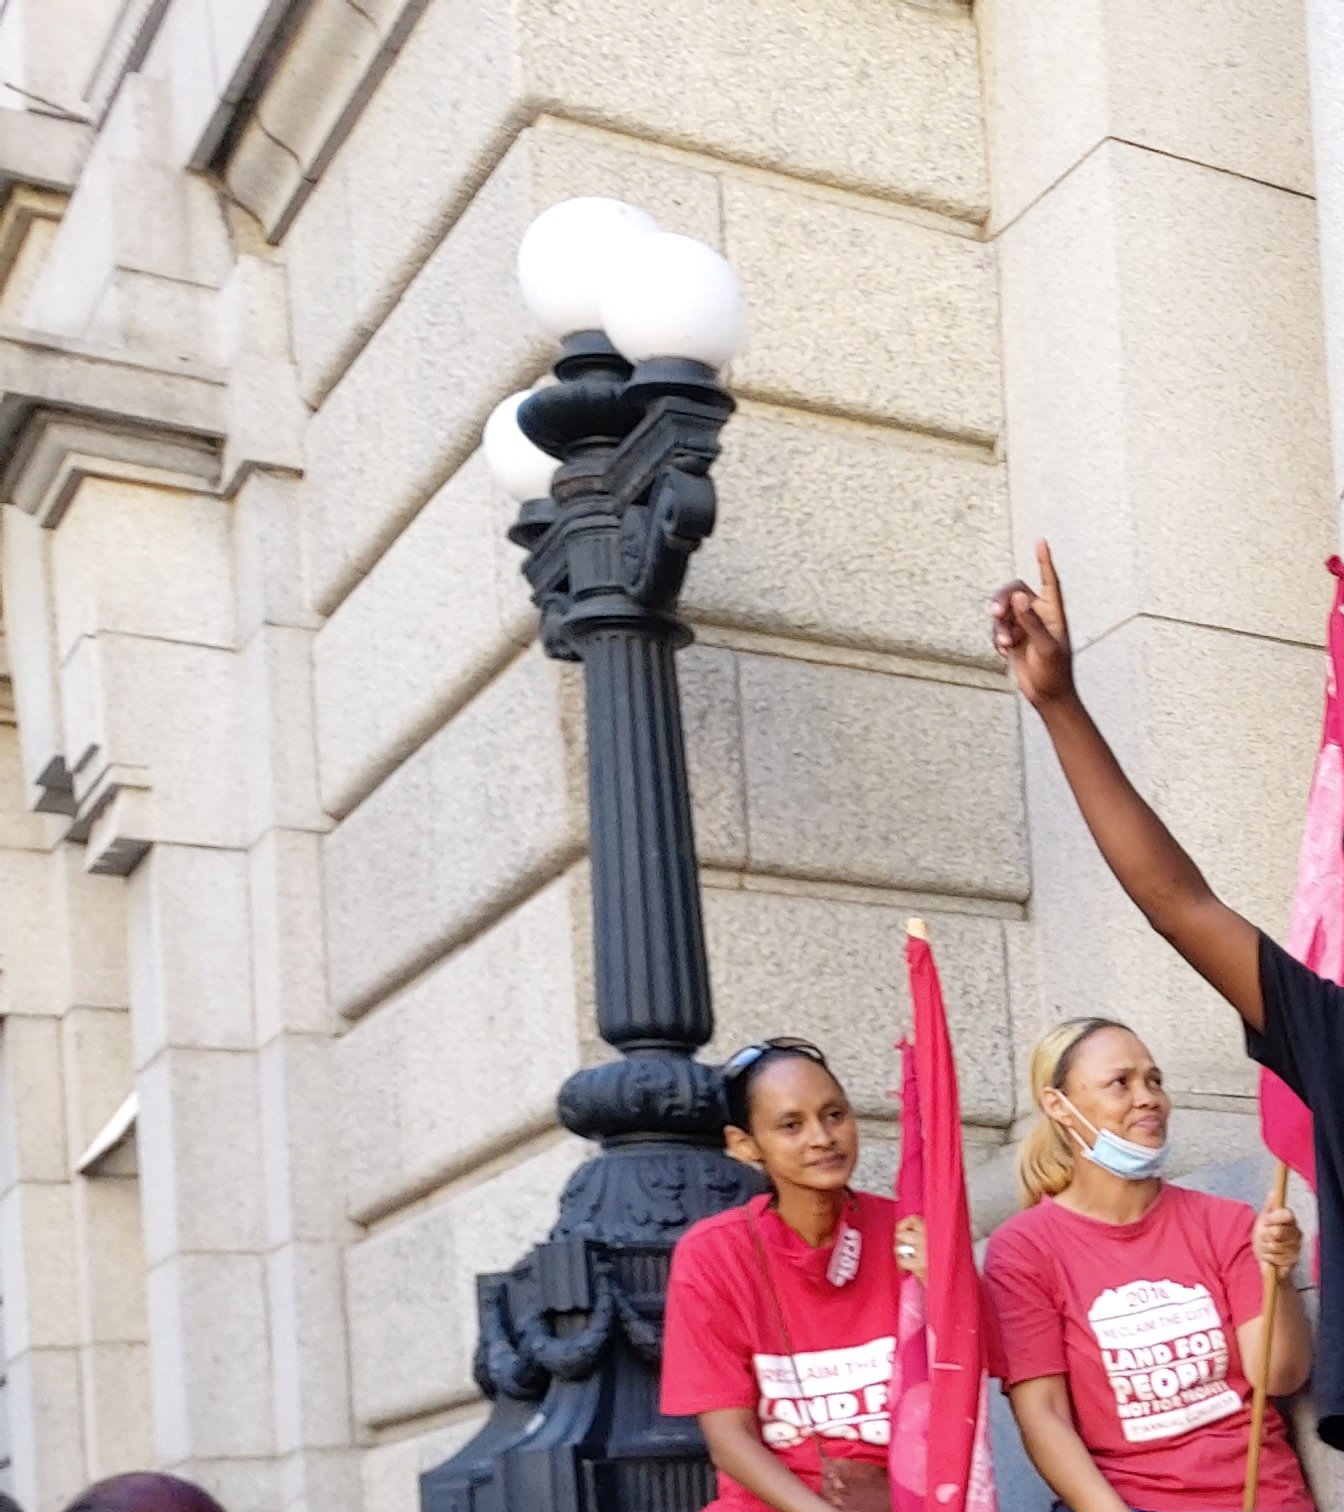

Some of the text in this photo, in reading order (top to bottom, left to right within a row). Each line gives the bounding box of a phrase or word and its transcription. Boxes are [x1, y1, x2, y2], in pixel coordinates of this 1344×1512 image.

[1102, 1329, 1228, 1371] LAND FOR
[1110, 1356, 1228, 1404] PEOPLE
